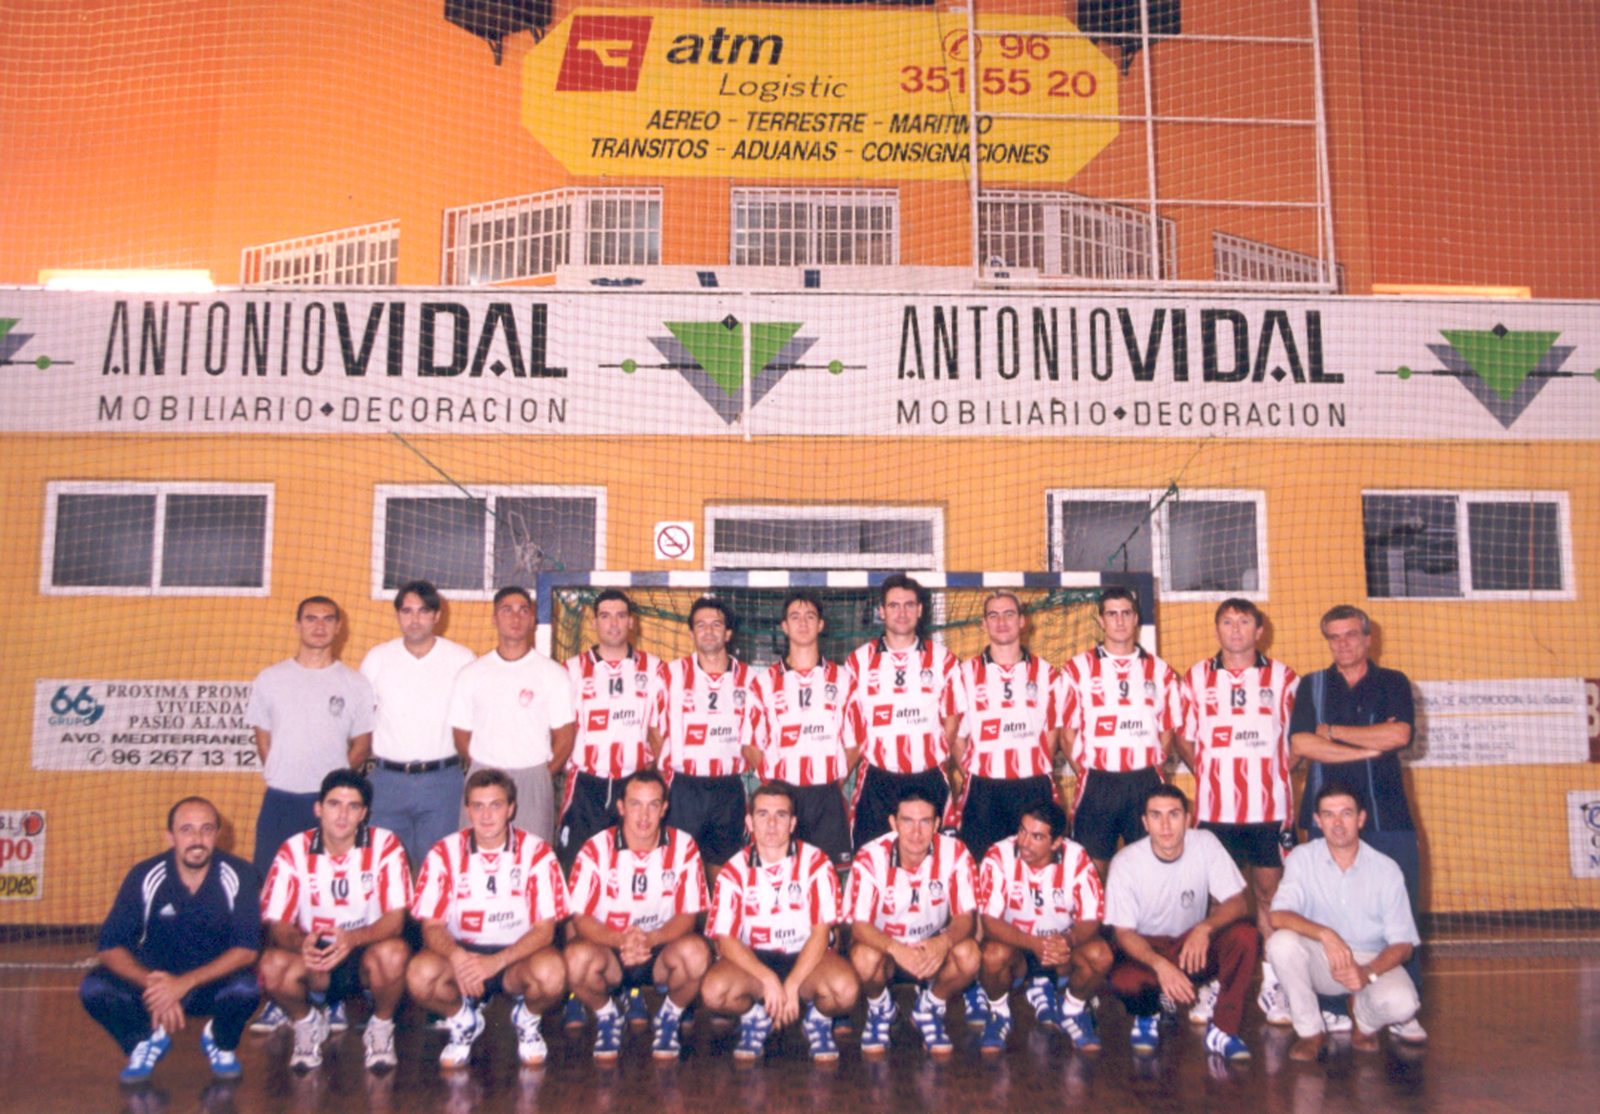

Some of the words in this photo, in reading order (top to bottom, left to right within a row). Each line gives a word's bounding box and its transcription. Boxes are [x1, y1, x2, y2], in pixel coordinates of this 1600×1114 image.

[666, 26, 784, 66] atm
[999, 34, 1051, 61] 96
[719, 73, 848, 102] Logistic
[900, 65, 966, 94] 351
[982, 67, 1031, 96] 55
[1047, 69, 1097, 98] 20
[646, 109, 721, 131] AEREO
[746, 111, 867, 133] TERRESTRE
[590, 137, 710, 159] TRANSITOS
[730, 139, 838, 162] ADUANAS
[861, 141, 1051, 165] CONSIGNACIONES
[98, 394, 313, 423] MOBILIARIO
[342, 396, 566, 424] DECORACION
[897, 400, 1107, 426] MOBILIARIO
[1133, 401, 1346, 428] DECORACION
[608, 677, 624, 696] 14
[894, 669, 906, 687] 8
[107, 684, 189, 698] PROXIMA
[798, 687, 813, 708] 12
[1003, 681, 1013, 700] 5
[1119, 680, 1130, 698] 9
[1230, 688, 1247, 707] 13
[707, 691, 718, 711] 2
[48, 716, 92, 727] GRUPO
[129, 715, 185, 729] PASEO
[612, 708, 635, 721] atm
[896, 706, 921, 719] atm
[709, 725, 732, 737] atm
[802, 723, 825, 735] atm
[1002, 720, 1027, 733] atm
[1119, 718, 1143, 730] atm
[61, 732, 105, 744] AVD.
[1234, 729, 1260, 740] atm
[112, 749, 141, 766] 96
[149, 750, 192, 767] 267
[202, 750, 224, 767] 13
[234, 750, 257, 767] 12
[331, 878, 350, 900] 10
[486, 875, 498, 895] 4
[631, 874, 648, 894] 19
[488, 910, 515, 923] atm
